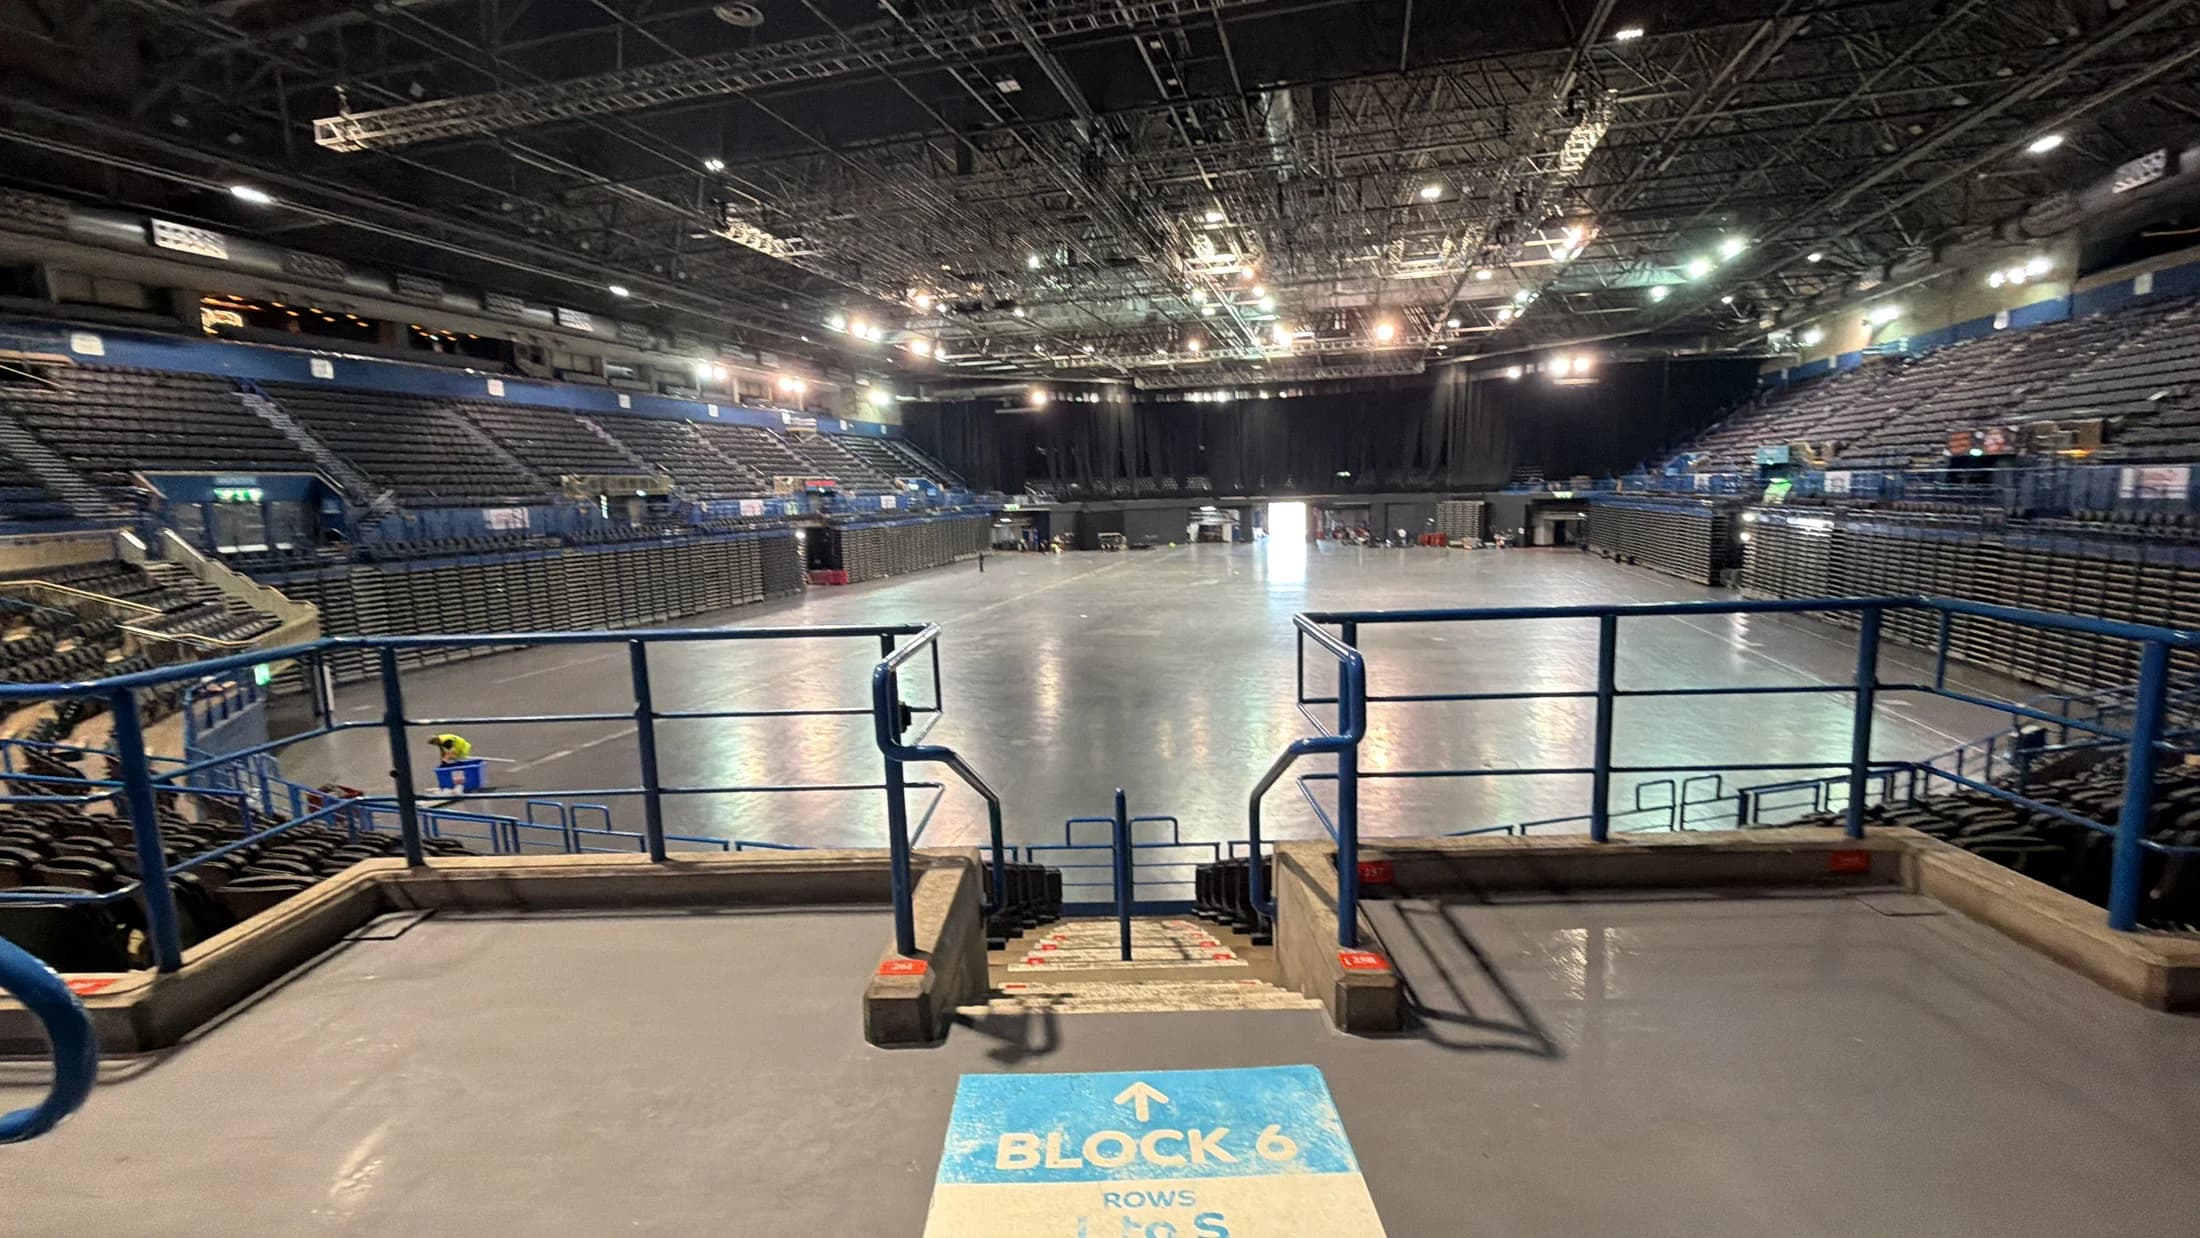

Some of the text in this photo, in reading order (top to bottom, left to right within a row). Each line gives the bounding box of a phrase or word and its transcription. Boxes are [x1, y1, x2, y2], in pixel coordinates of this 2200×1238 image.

[995, 1124, 1299, 1170] BLOCK 6
[1103, 1190, 1197, 1209] ROWS
[1194, 1212, 1231, 1238] S
